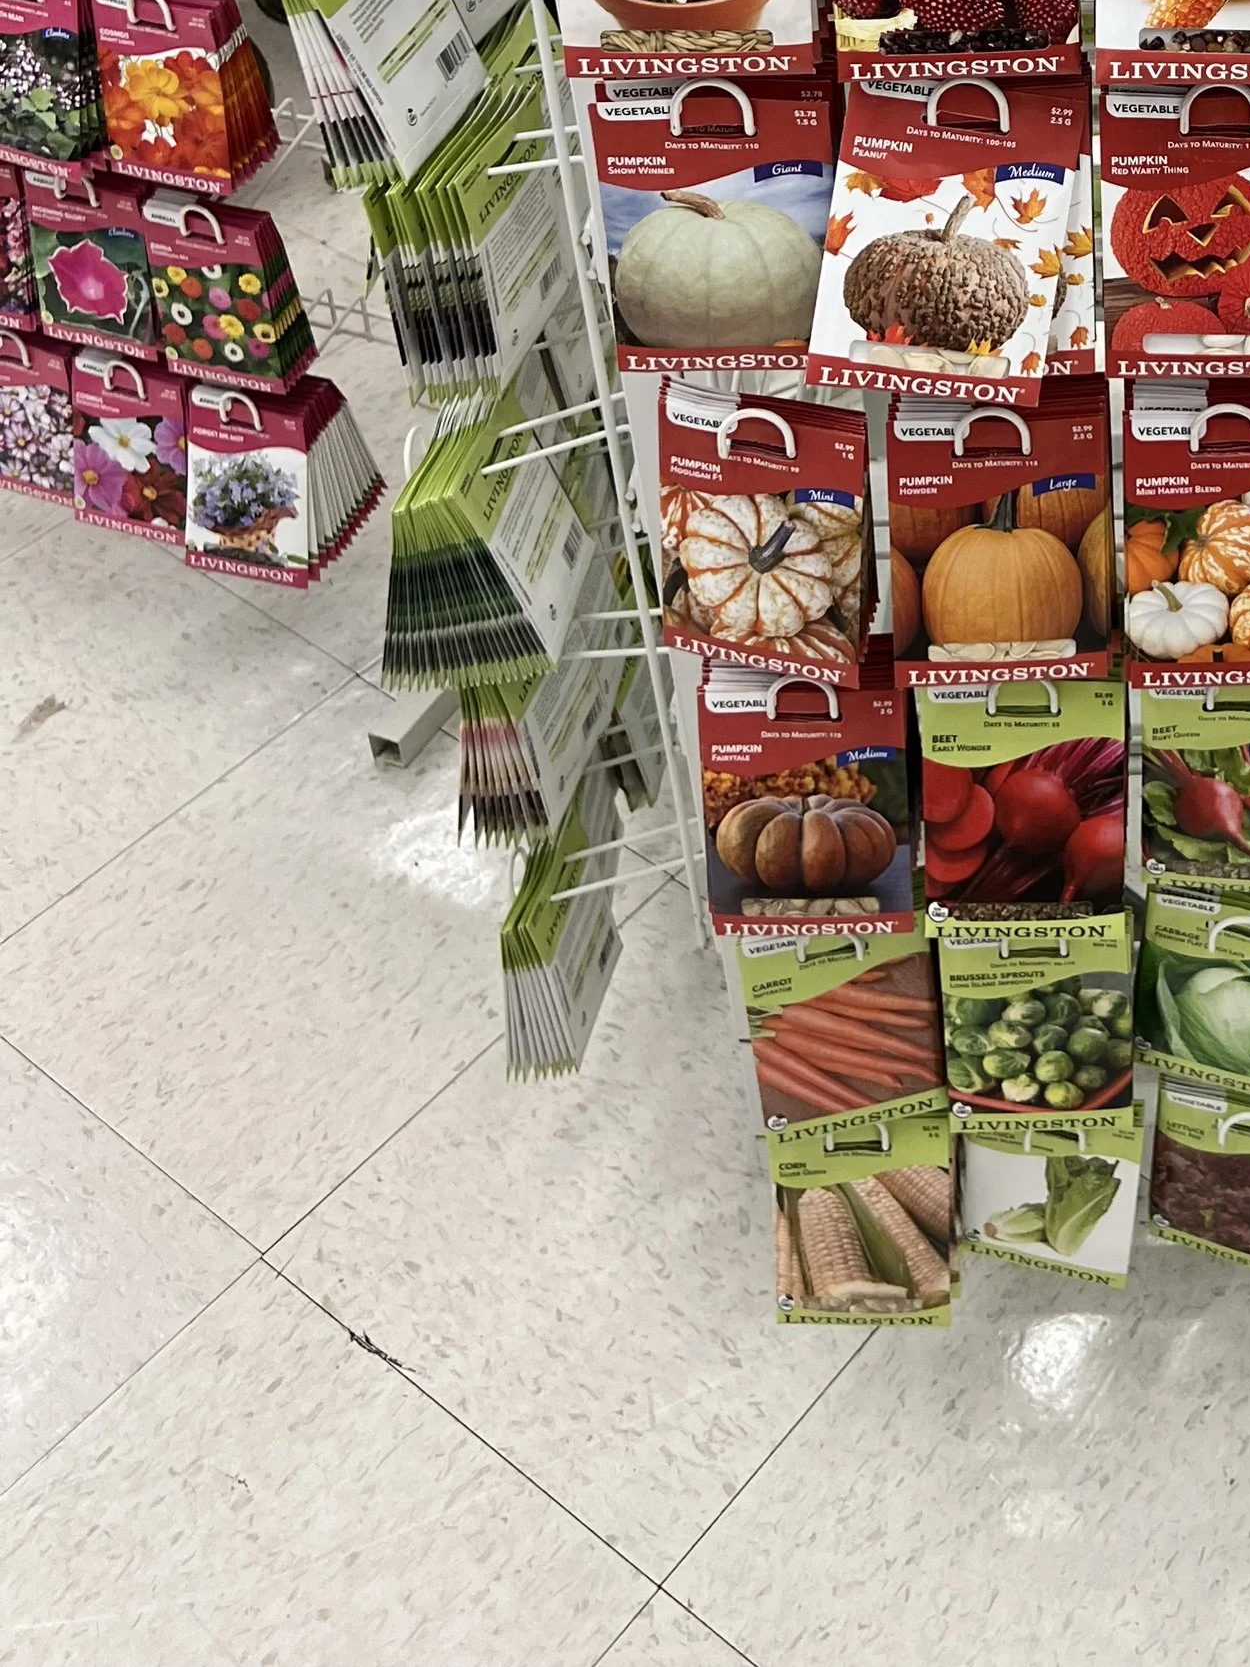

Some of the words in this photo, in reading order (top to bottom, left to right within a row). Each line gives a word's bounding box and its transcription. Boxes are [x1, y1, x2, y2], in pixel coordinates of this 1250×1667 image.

[578, 55, 792, 75] LIVINGSTON
[850, 57, 1060, 80] LIVINGSTON
[1113, 103, 1180, 115] VEGETABLE
[854, 136, 913, 153] PUMPKIN
[607, 157, 666, 166] PUMPKIN
[1111, 156, 1168, 166] PUMPKIN
[772, 162, 803, 176] Giant
[1008, 164, 1056, 181] Medium
[118, 163, 221, 192] LIVINGSTON
[819, 367, 1019, 403] LIVINGSTON
[670, 456, 721, 472] PUMPKIN
[899, 475, 953, 486] PUMPKIN
[1048, 478, 1077, 491] Large
[1136, 476, 1189, 487] PUMPKIN
[808, 489, 834, 502] Mini
[190, 555, 294, 582] LIVINGSTON
[674, 638, 841, 683] LIVINGSTON
[932, 735, 958, 744] BEET
[711, 744, 762, 754] PUMPKIN
[846, 747, 888, 763] Medium
[936, 925, 1107, 938] LIVINGSTON
[777, 1098, 934, 1144] LIVINGSTON
